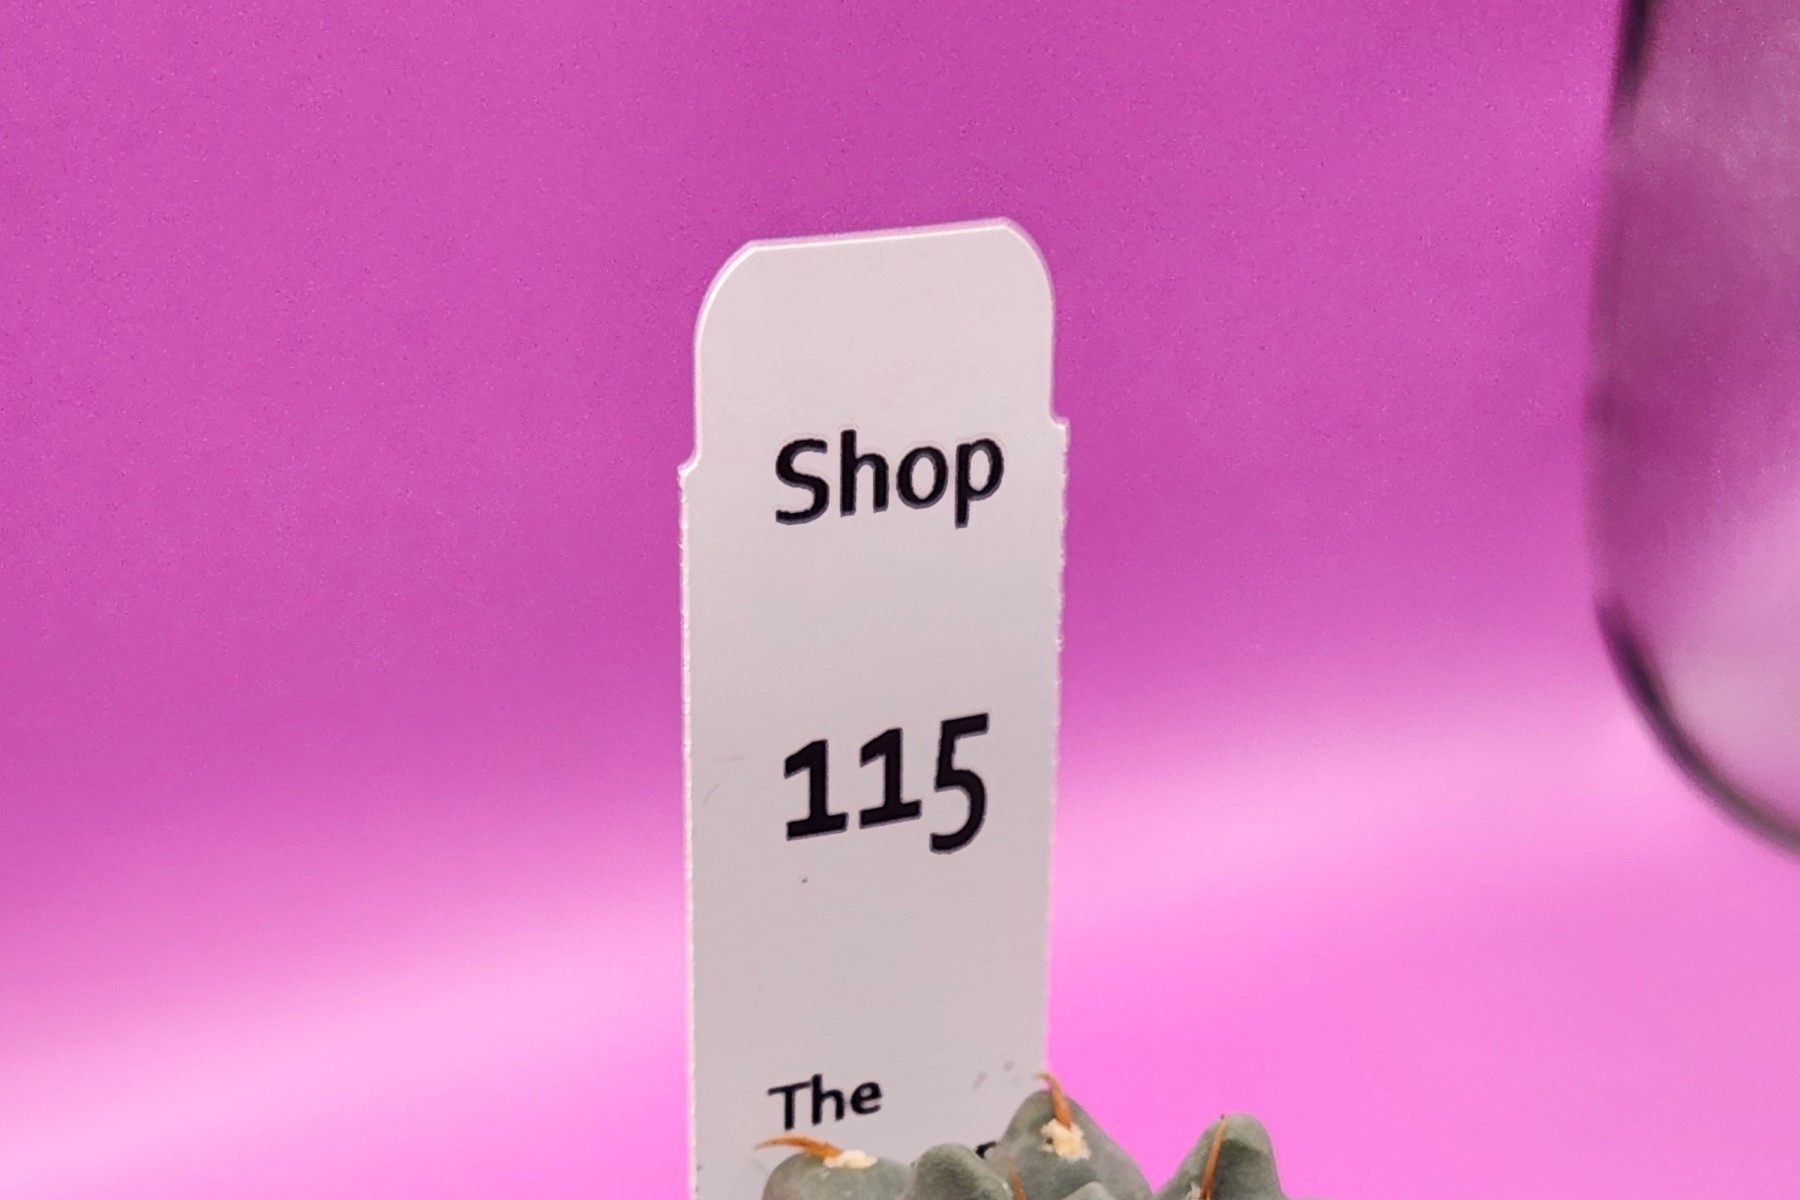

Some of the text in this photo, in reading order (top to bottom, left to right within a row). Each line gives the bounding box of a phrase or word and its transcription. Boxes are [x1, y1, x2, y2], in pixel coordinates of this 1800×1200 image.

[775, 429, 1005, 530] Shop
[783, 713, 990, 855] 115
[767, 1073, 883, 1131] The
